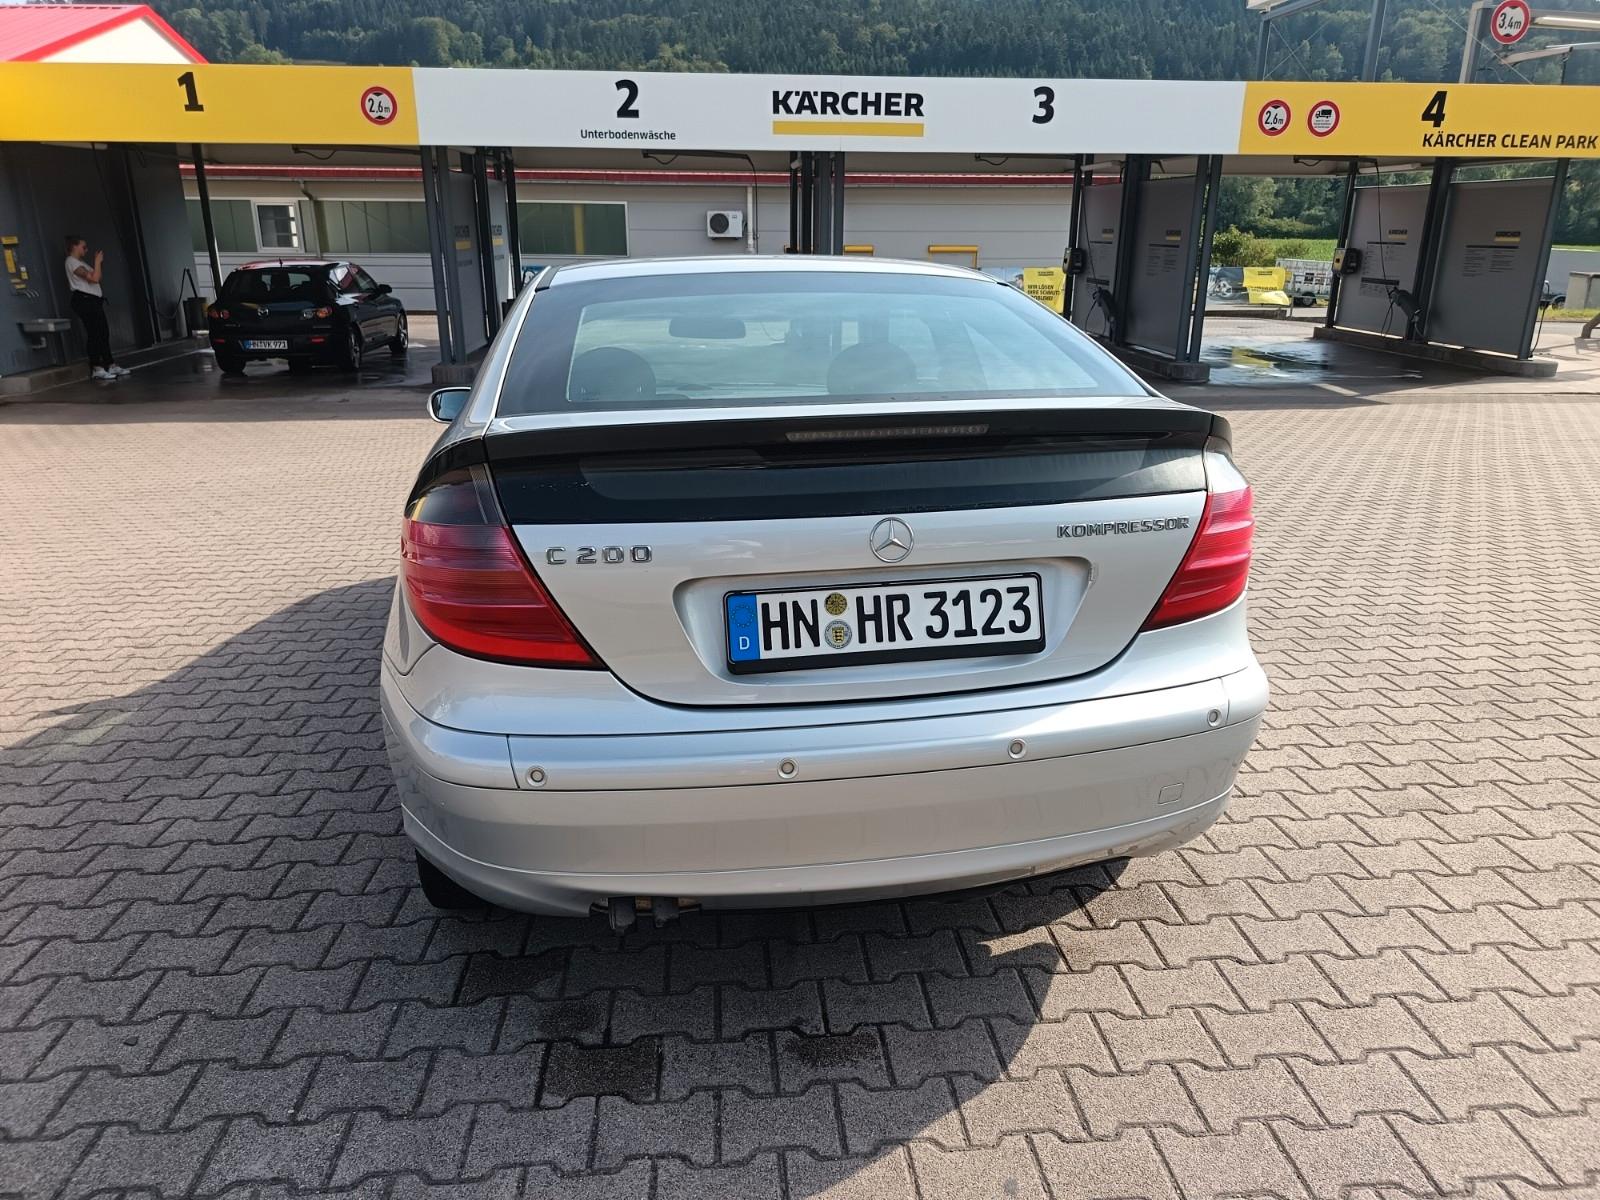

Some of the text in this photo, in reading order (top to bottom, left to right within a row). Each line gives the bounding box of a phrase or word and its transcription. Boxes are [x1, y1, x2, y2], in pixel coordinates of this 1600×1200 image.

[177, 71, 204, 112] 1
[615, 79, 640, 119] 2
[772, 90, 925, 117] KÄRCHER
[1032, 86, 1055, 124] 3
[1421, 90, 1448, 128] 4
[580, 129, 676, 141] Unterbodenwäsche
[1422, 131, 1599, 149] KÄRCHER CLEAN PARK
[1057, 515, 1190, 539] KOMPRESSOR
[545, 545, 652, 565] C 200
[760, 599, 821, 651] HN
[855, 594, 914, 644] HR
[923, 586, 1032, 639] 3123
[738, 636, 750, 651] D
